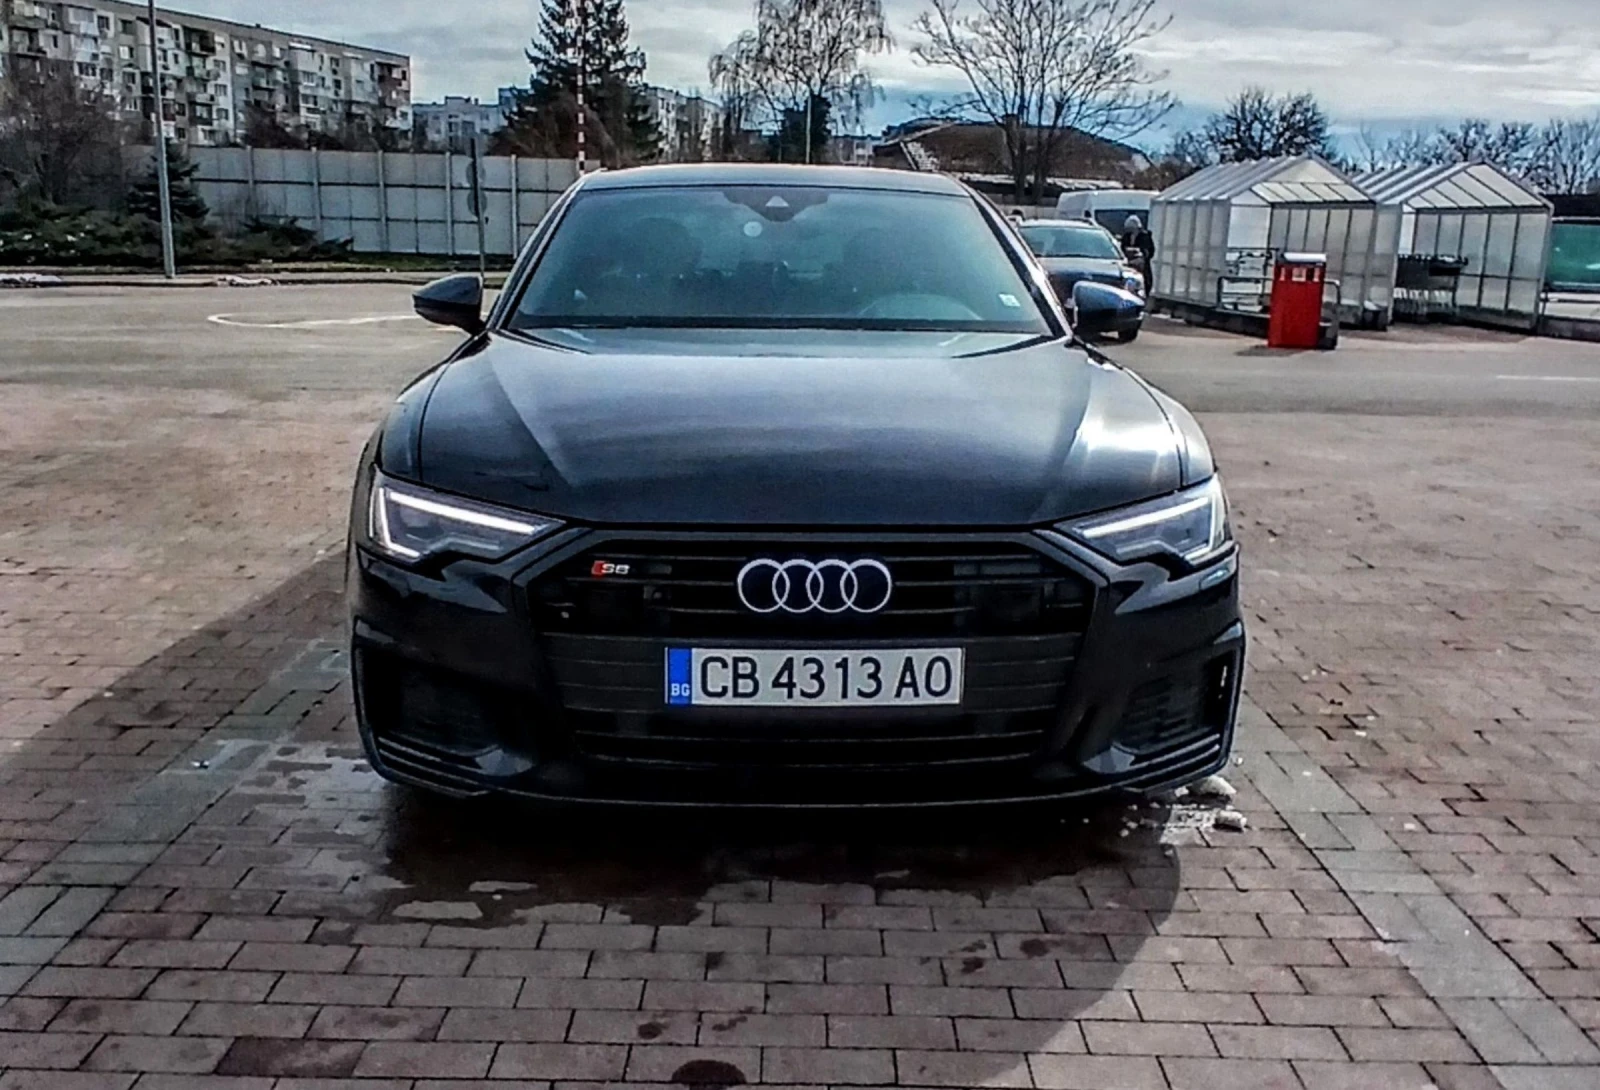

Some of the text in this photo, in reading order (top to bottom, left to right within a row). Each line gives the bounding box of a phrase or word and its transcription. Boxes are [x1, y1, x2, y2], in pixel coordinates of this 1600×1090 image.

[671, 683, 690, 697] BG
[700, 656, 953, 699] CB 4313 AO
